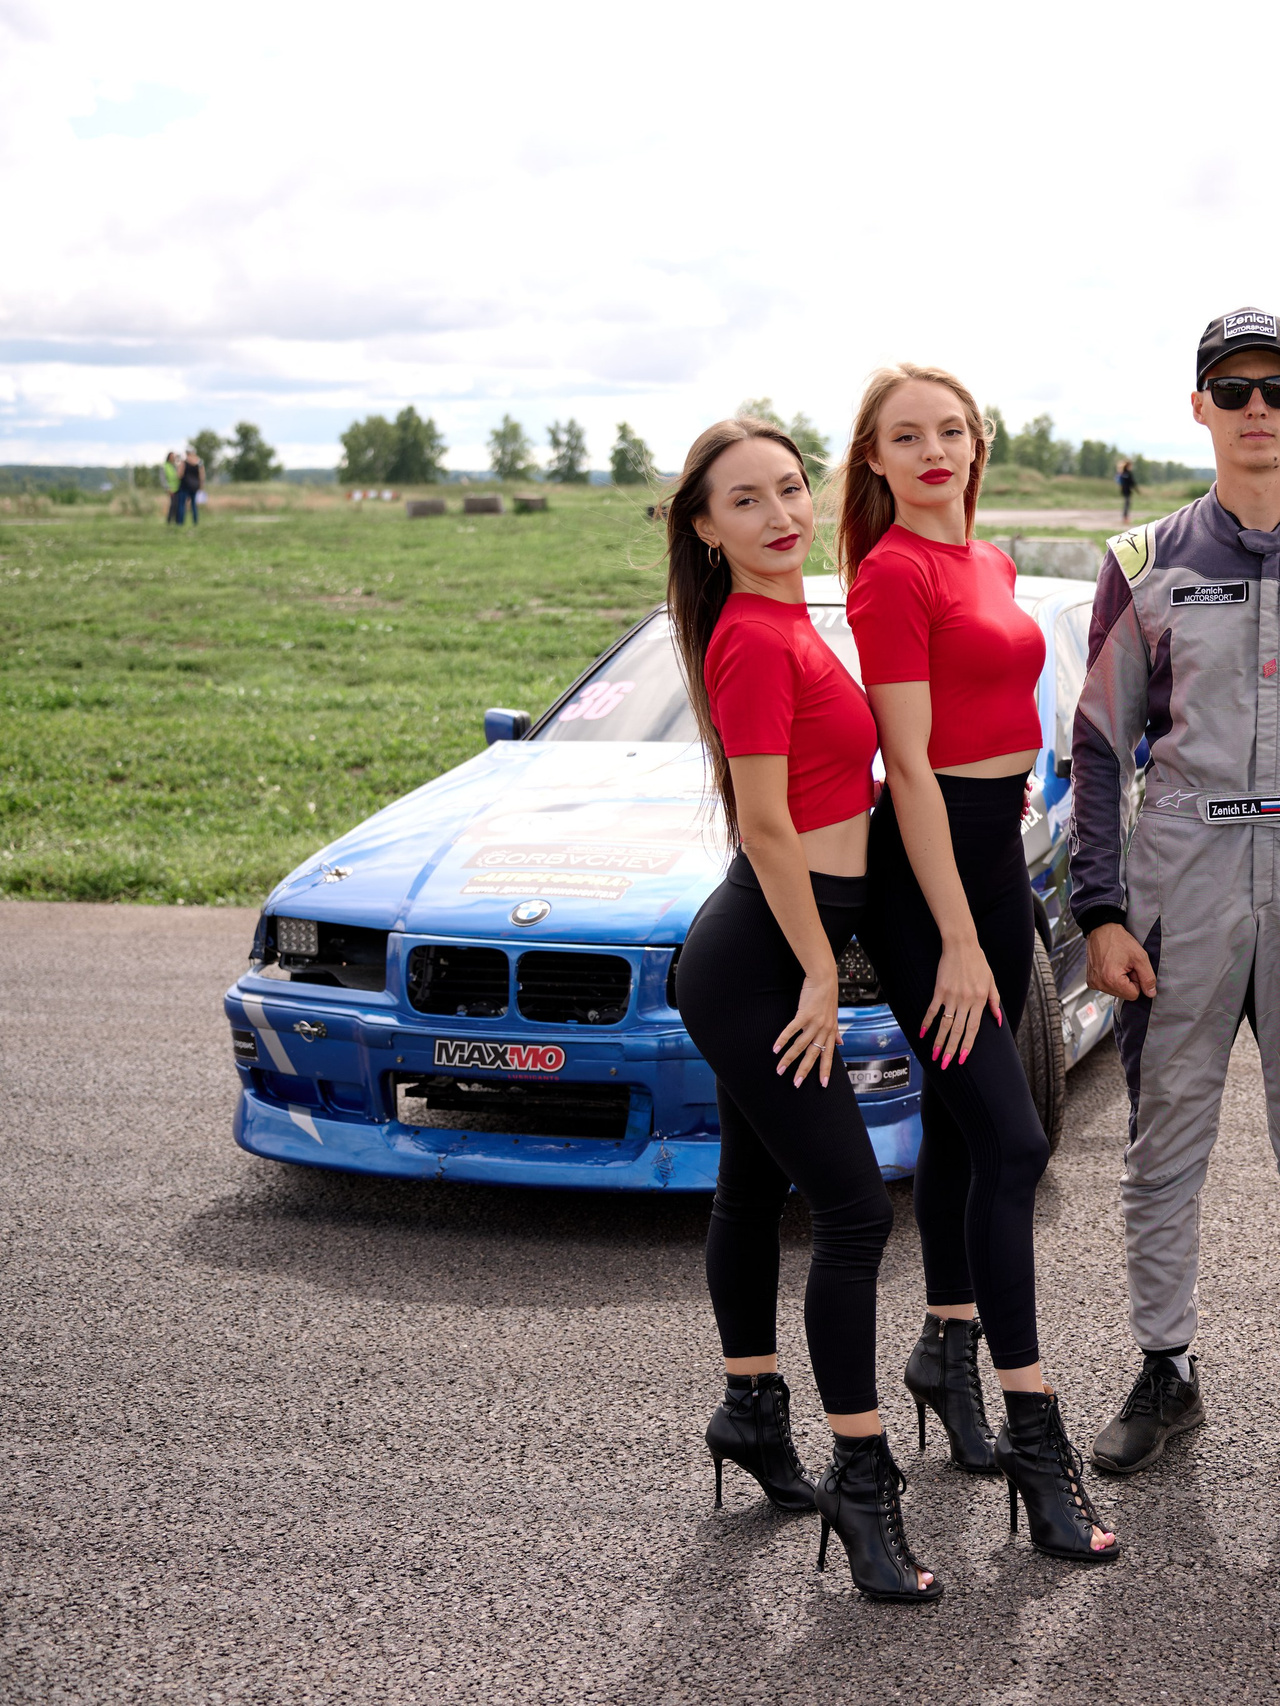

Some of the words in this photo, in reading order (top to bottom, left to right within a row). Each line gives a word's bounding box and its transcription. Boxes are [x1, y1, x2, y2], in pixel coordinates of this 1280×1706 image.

[1226, 313, 1273, 328] Zenich
[1227, 325, 1274, 336] MOTORSPORT
[1195, 586, 1223, 595] Zenich
[1184, 594, 1233, 602] MOTORSPORT
[559, 681, 636, 721] 36
[1211, 803, 1240, 816] Zenich
[1241, 803, 1260, 814] E.A.
